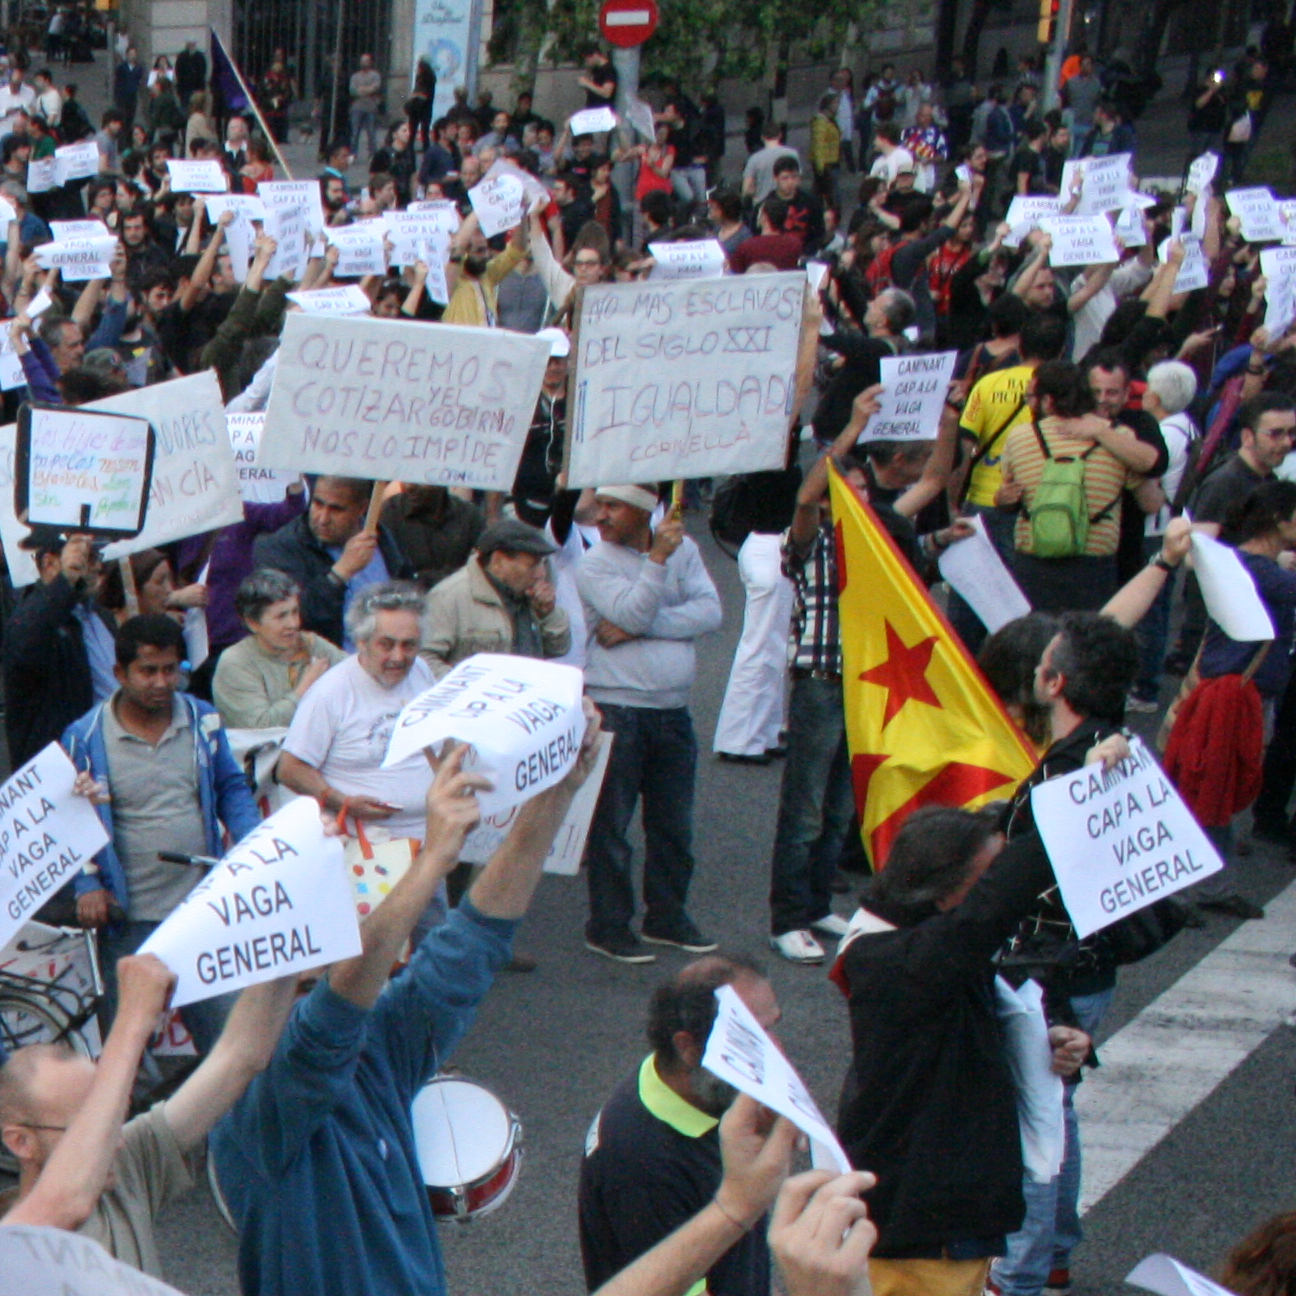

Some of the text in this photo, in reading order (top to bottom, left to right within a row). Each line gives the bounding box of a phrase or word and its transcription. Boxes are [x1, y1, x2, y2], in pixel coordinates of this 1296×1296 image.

[298, 333, 512, 401] QUEREMOS
[302, 426, 357, 457] NOS
[362, 433, 397, 461] LO
[506, 697, 566, 735] VAGA
[515, 726, 579, 791] GENERAL
[16, 820, 28, 837] A
[33, 797, 55, 826] LA
[1085, 805, 1124, 840] CAP
[1127, 792, 1144, 816] A
[8, 831, 57, 878] VAGA
[250, 840, 297, 863] LA
[1112, 821, 1173, 867] VAGA
[8, 845, 81, 920] GENERAL
[208, 882, 292, 926] VAGA
[1100, 851, 1203, 914] GENERAL
[196, 924, 321, 984] GENERAL
